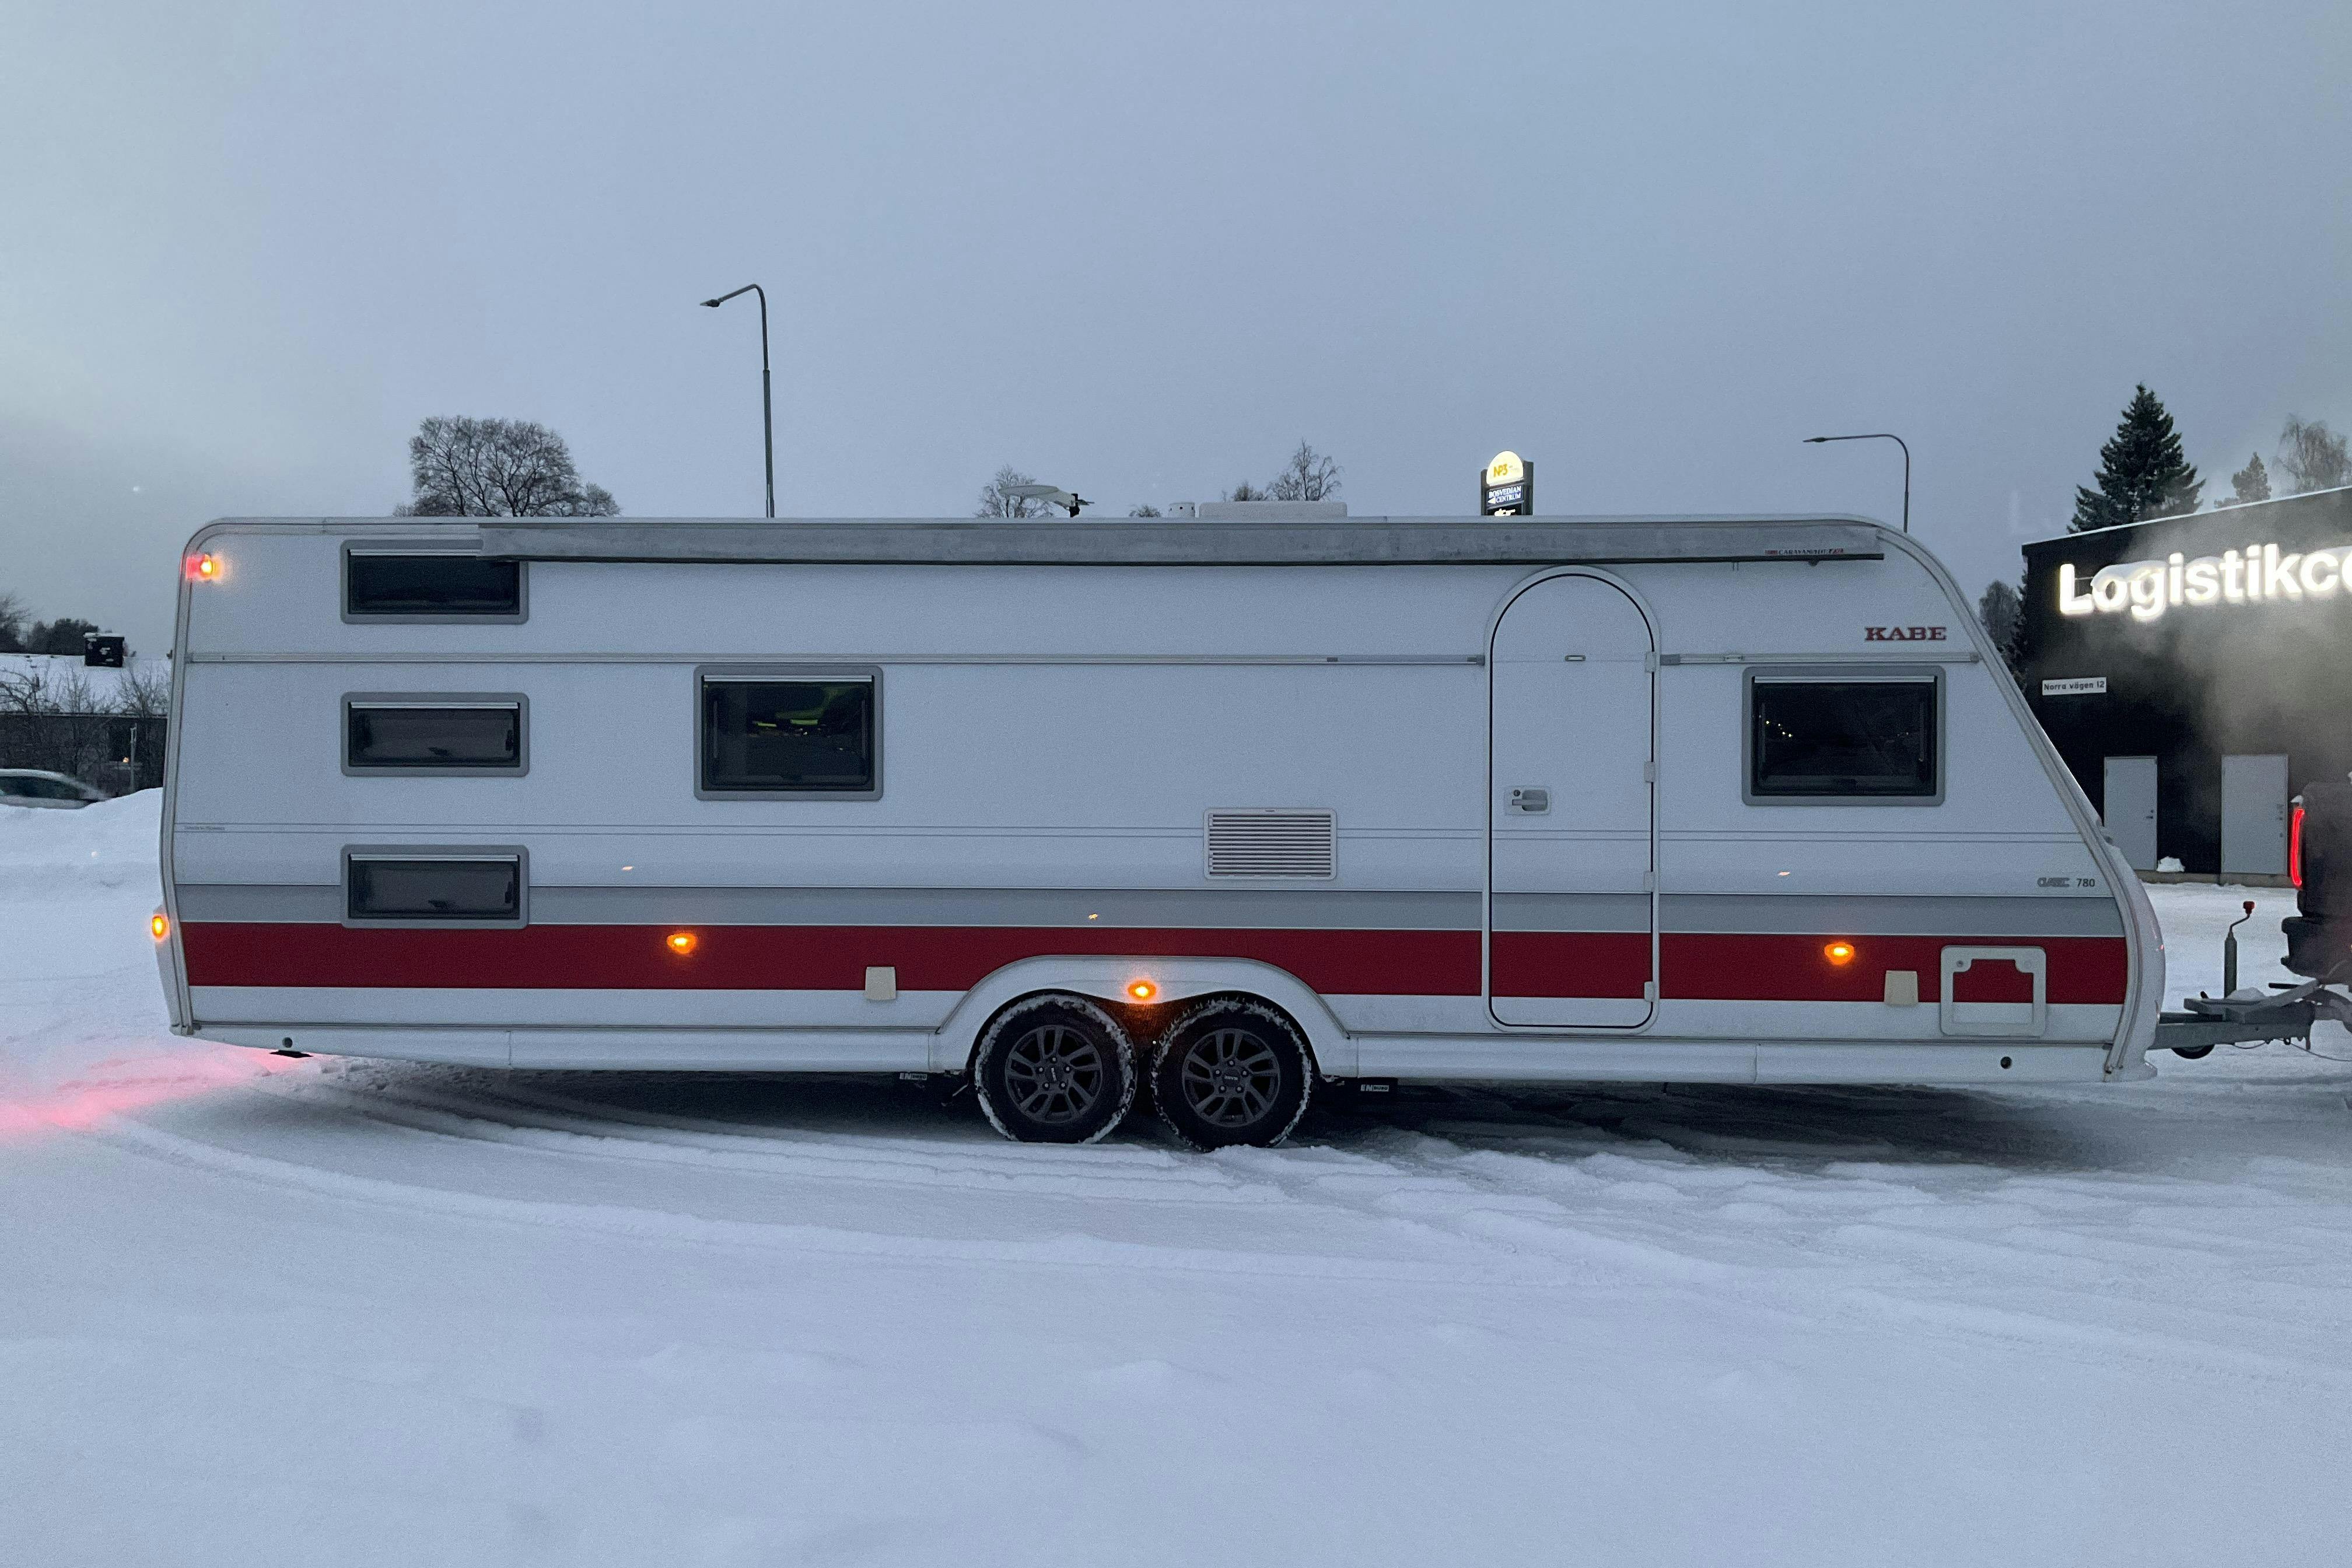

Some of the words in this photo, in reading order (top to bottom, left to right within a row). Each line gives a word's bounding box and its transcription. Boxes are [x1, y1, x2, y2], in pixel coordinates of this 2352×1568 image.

[1496, 493, 1521, 503] CENTRUM
[2060, 543, 2352, 620] Logistikc
[1865, 626, 1947, 641] KABE
[2069, 682, 2094, 691] vägen
[2076, 878, 2095, 887] 780
